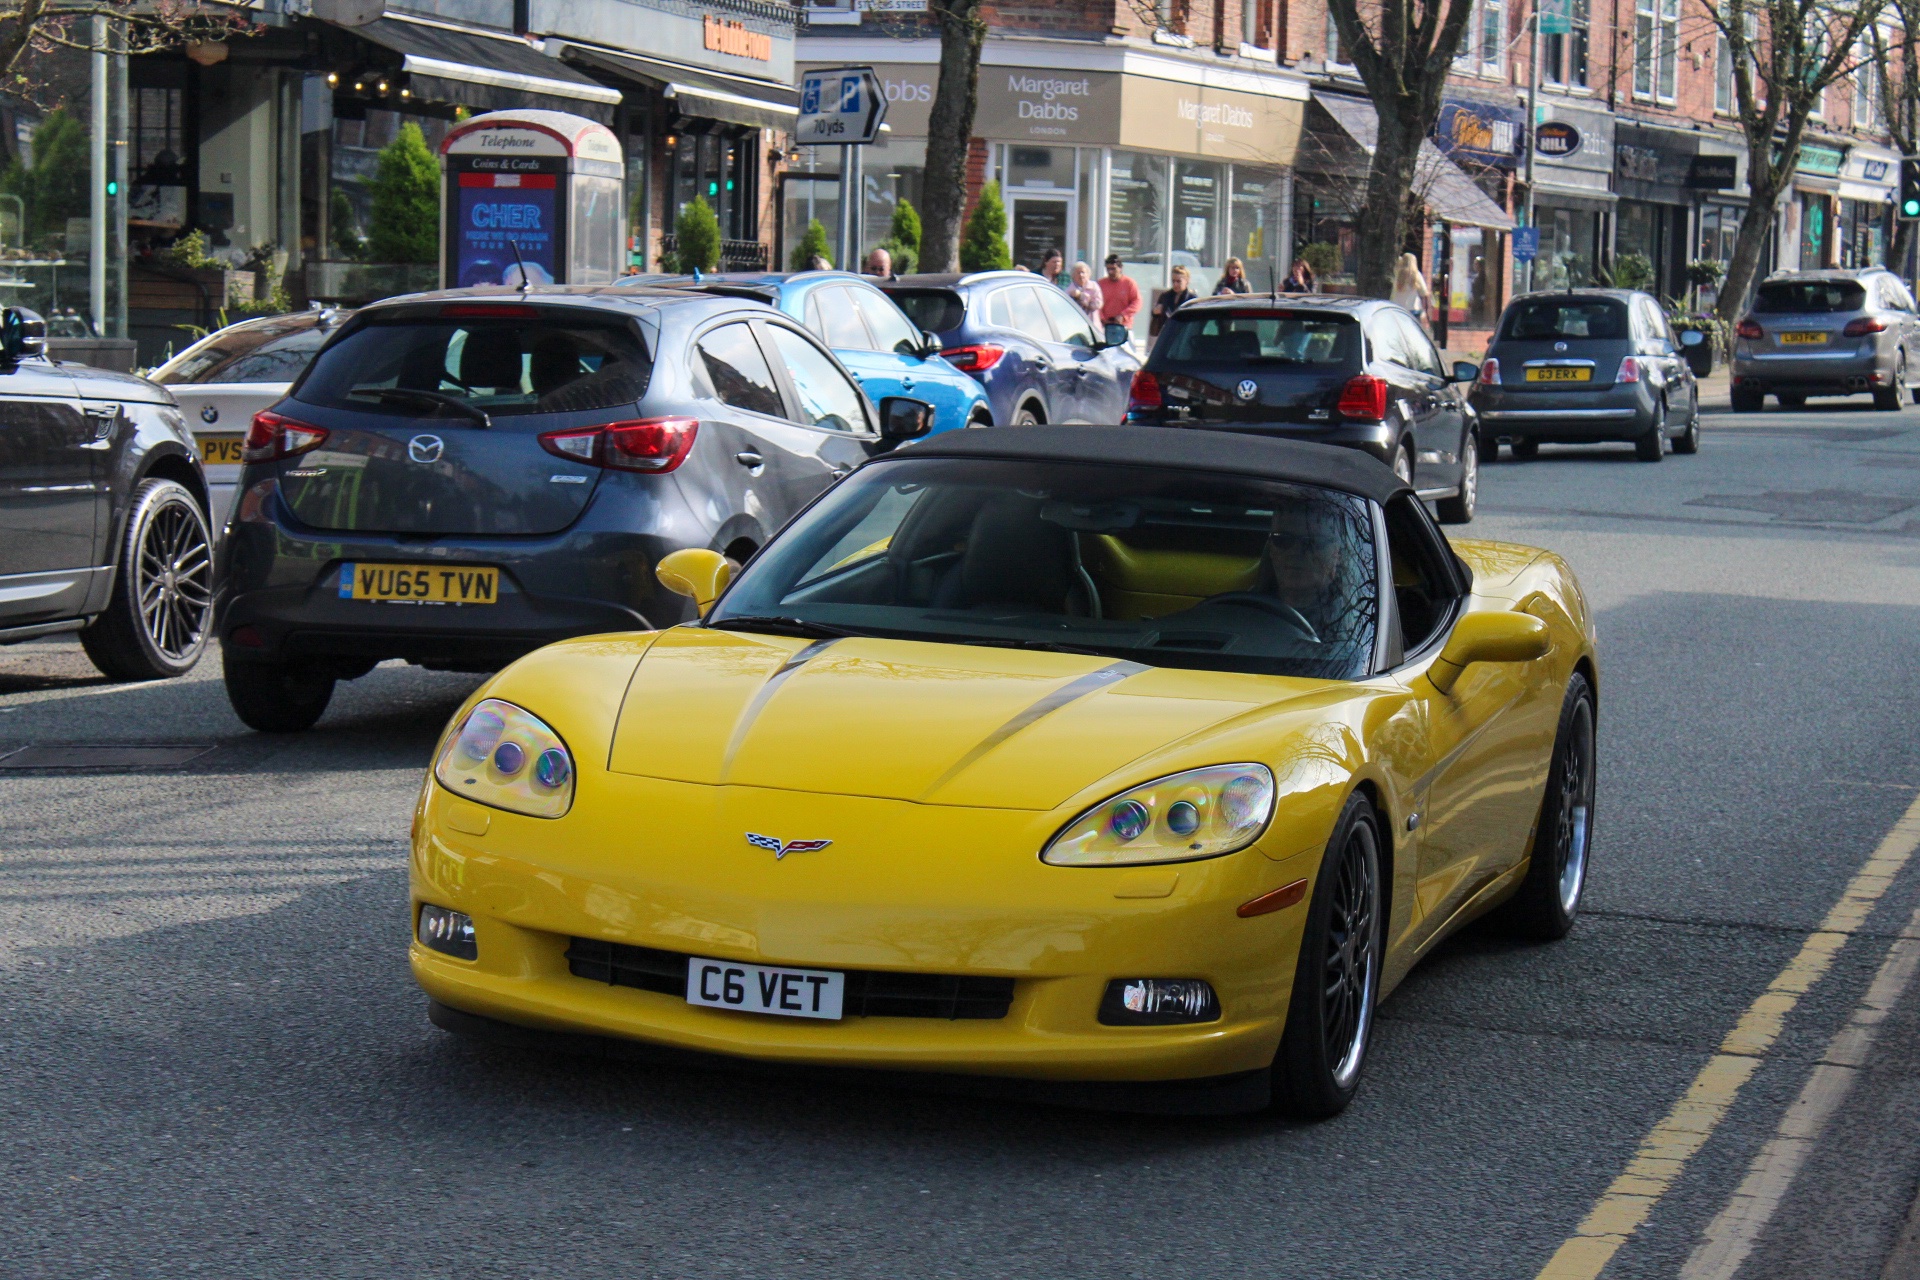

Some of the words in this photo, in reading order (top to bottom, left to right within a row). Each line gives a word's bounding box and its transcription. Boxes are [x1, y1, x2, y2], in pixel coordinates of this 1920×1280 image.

[896, 1, 926, 9] STREET
[885, 79, 932, 102] bbs
[1008, 75, 1090, 100] Margaret
[1018, 100, 1079, 121] Dabbs
[1177, 98, 1221, 129] Margaret
[1221, 102, 1254, 128] Dabbs
[813, 119, 826, 135] 70
[826, 119, 845, 137] yds
[1029, 126, 1067, 135] LONDON
[480, 134, 536, 149] Telephone
[1540, 137, 1568, 151] HILL
[472, 158, 499, 169] Coins
[500, 159, 509, 169] &
[511, 159, 540, 170] Cards
[472, 203, 541, 228] CHER
[1537, 368, 1554, 380] G3
[1555, 368, 1578, 380] ERX
[204, 442, 243, 461] PVS
[361, 568, 430, 597] VU65
[439, 571, 493, 600] TVN
[700, 965, 746, 1005] C6
[758, 971, 829, 1012] VET
